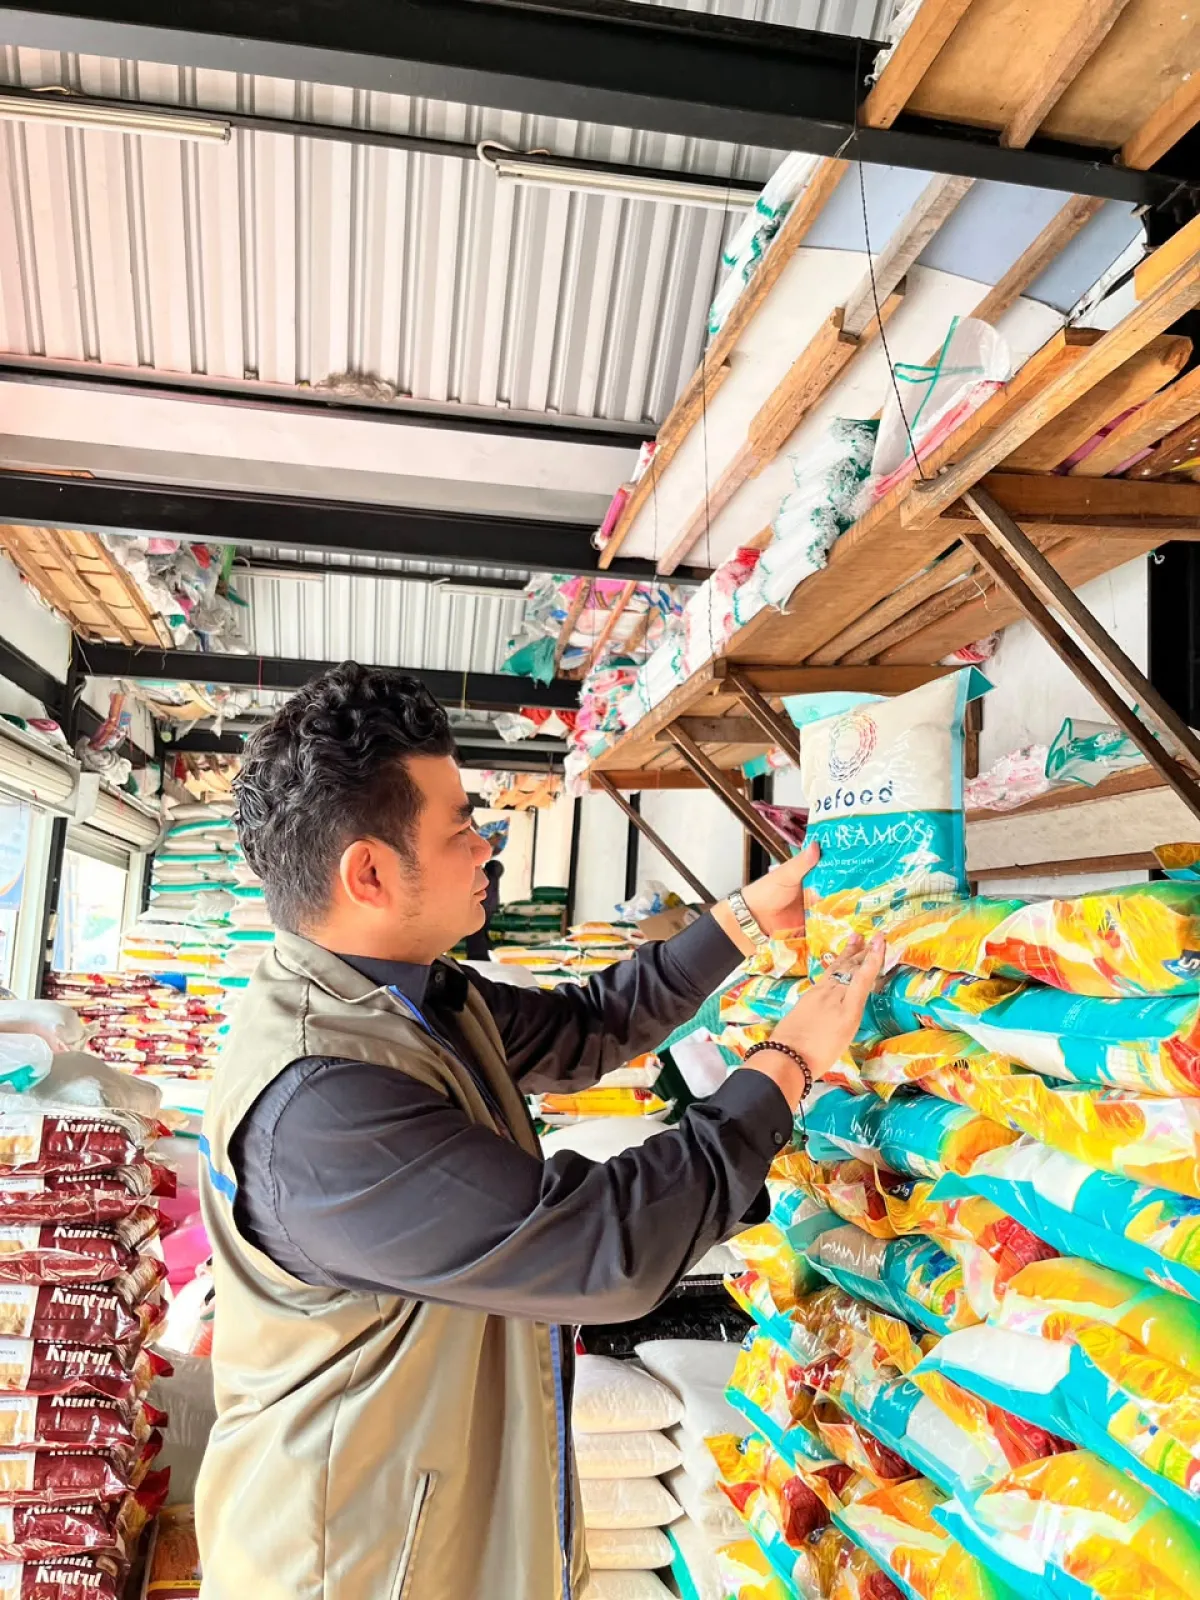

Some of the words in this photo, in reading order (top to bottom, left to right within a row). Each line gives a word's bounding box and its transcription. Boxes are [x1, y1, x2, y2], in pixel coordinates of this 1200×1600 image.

[50, 1287, 119, 1311] Kuntul
[45, 1344, 113, 1366] Kuntul
[34, 1565, 102, 1588] Kuntul
